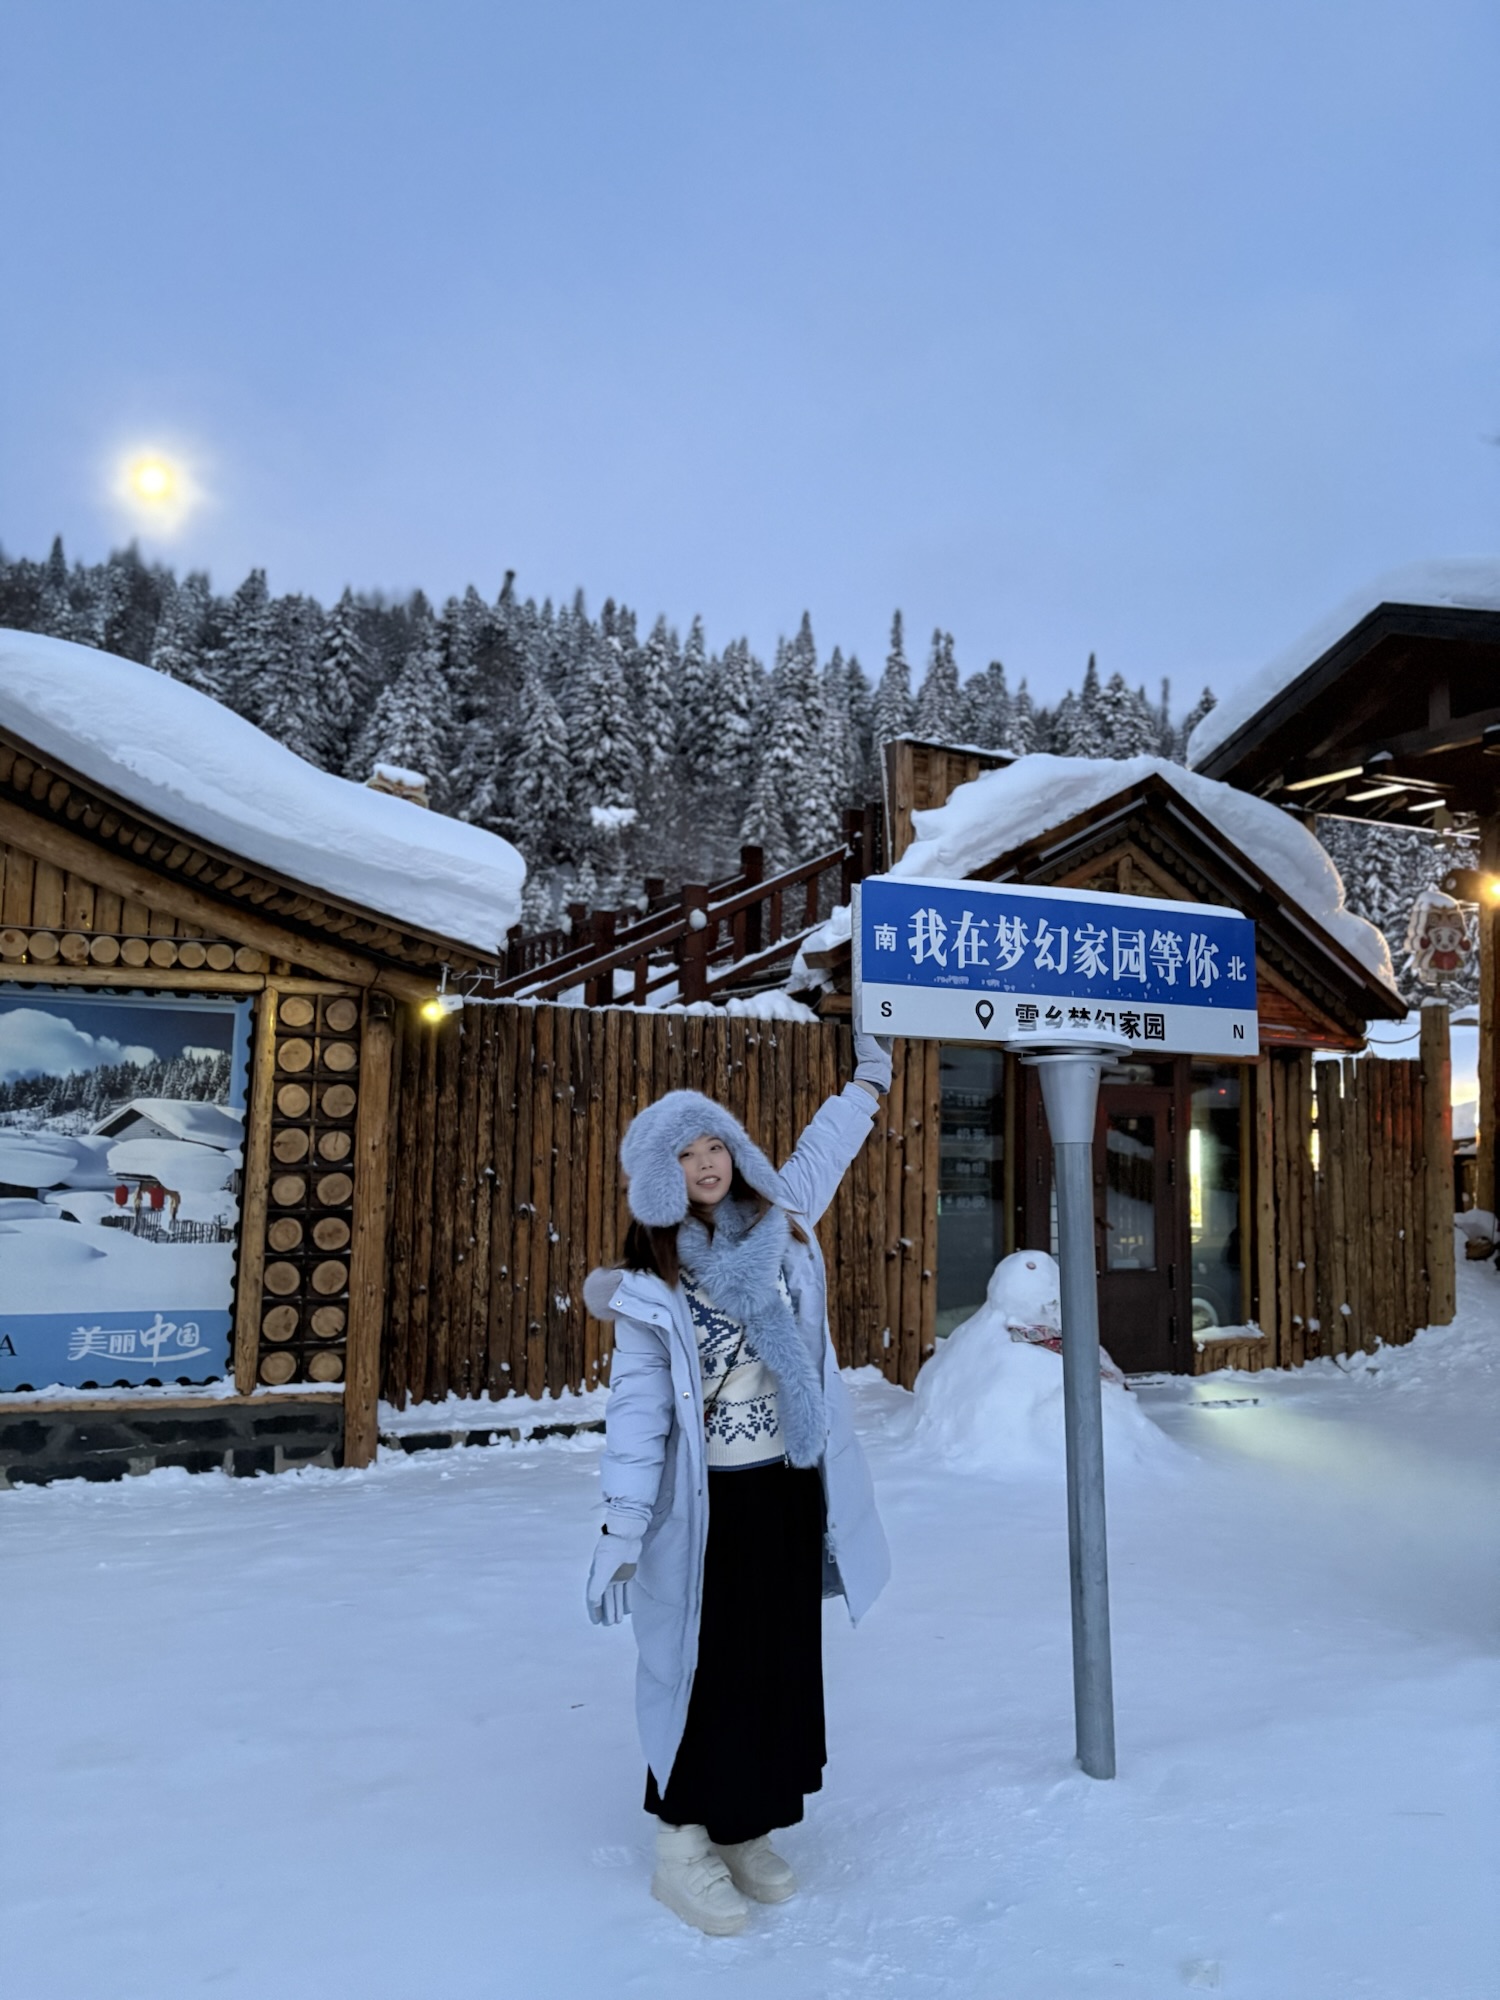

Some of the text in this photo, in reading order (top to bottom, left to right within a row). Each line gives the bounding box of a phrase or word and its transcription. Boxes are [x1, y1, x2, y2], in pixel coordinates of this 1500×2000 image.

[873, 922, 898, 952] 南
[907, 907, 1220, 989] 我在梦幻家园等你
[1227, 955, 1248, 982] 北
[880, 1001, 893, 1018] S
[1232, 1023, 1244, 1040] N
[67, 1313, 211, 1367] 美丽中国
